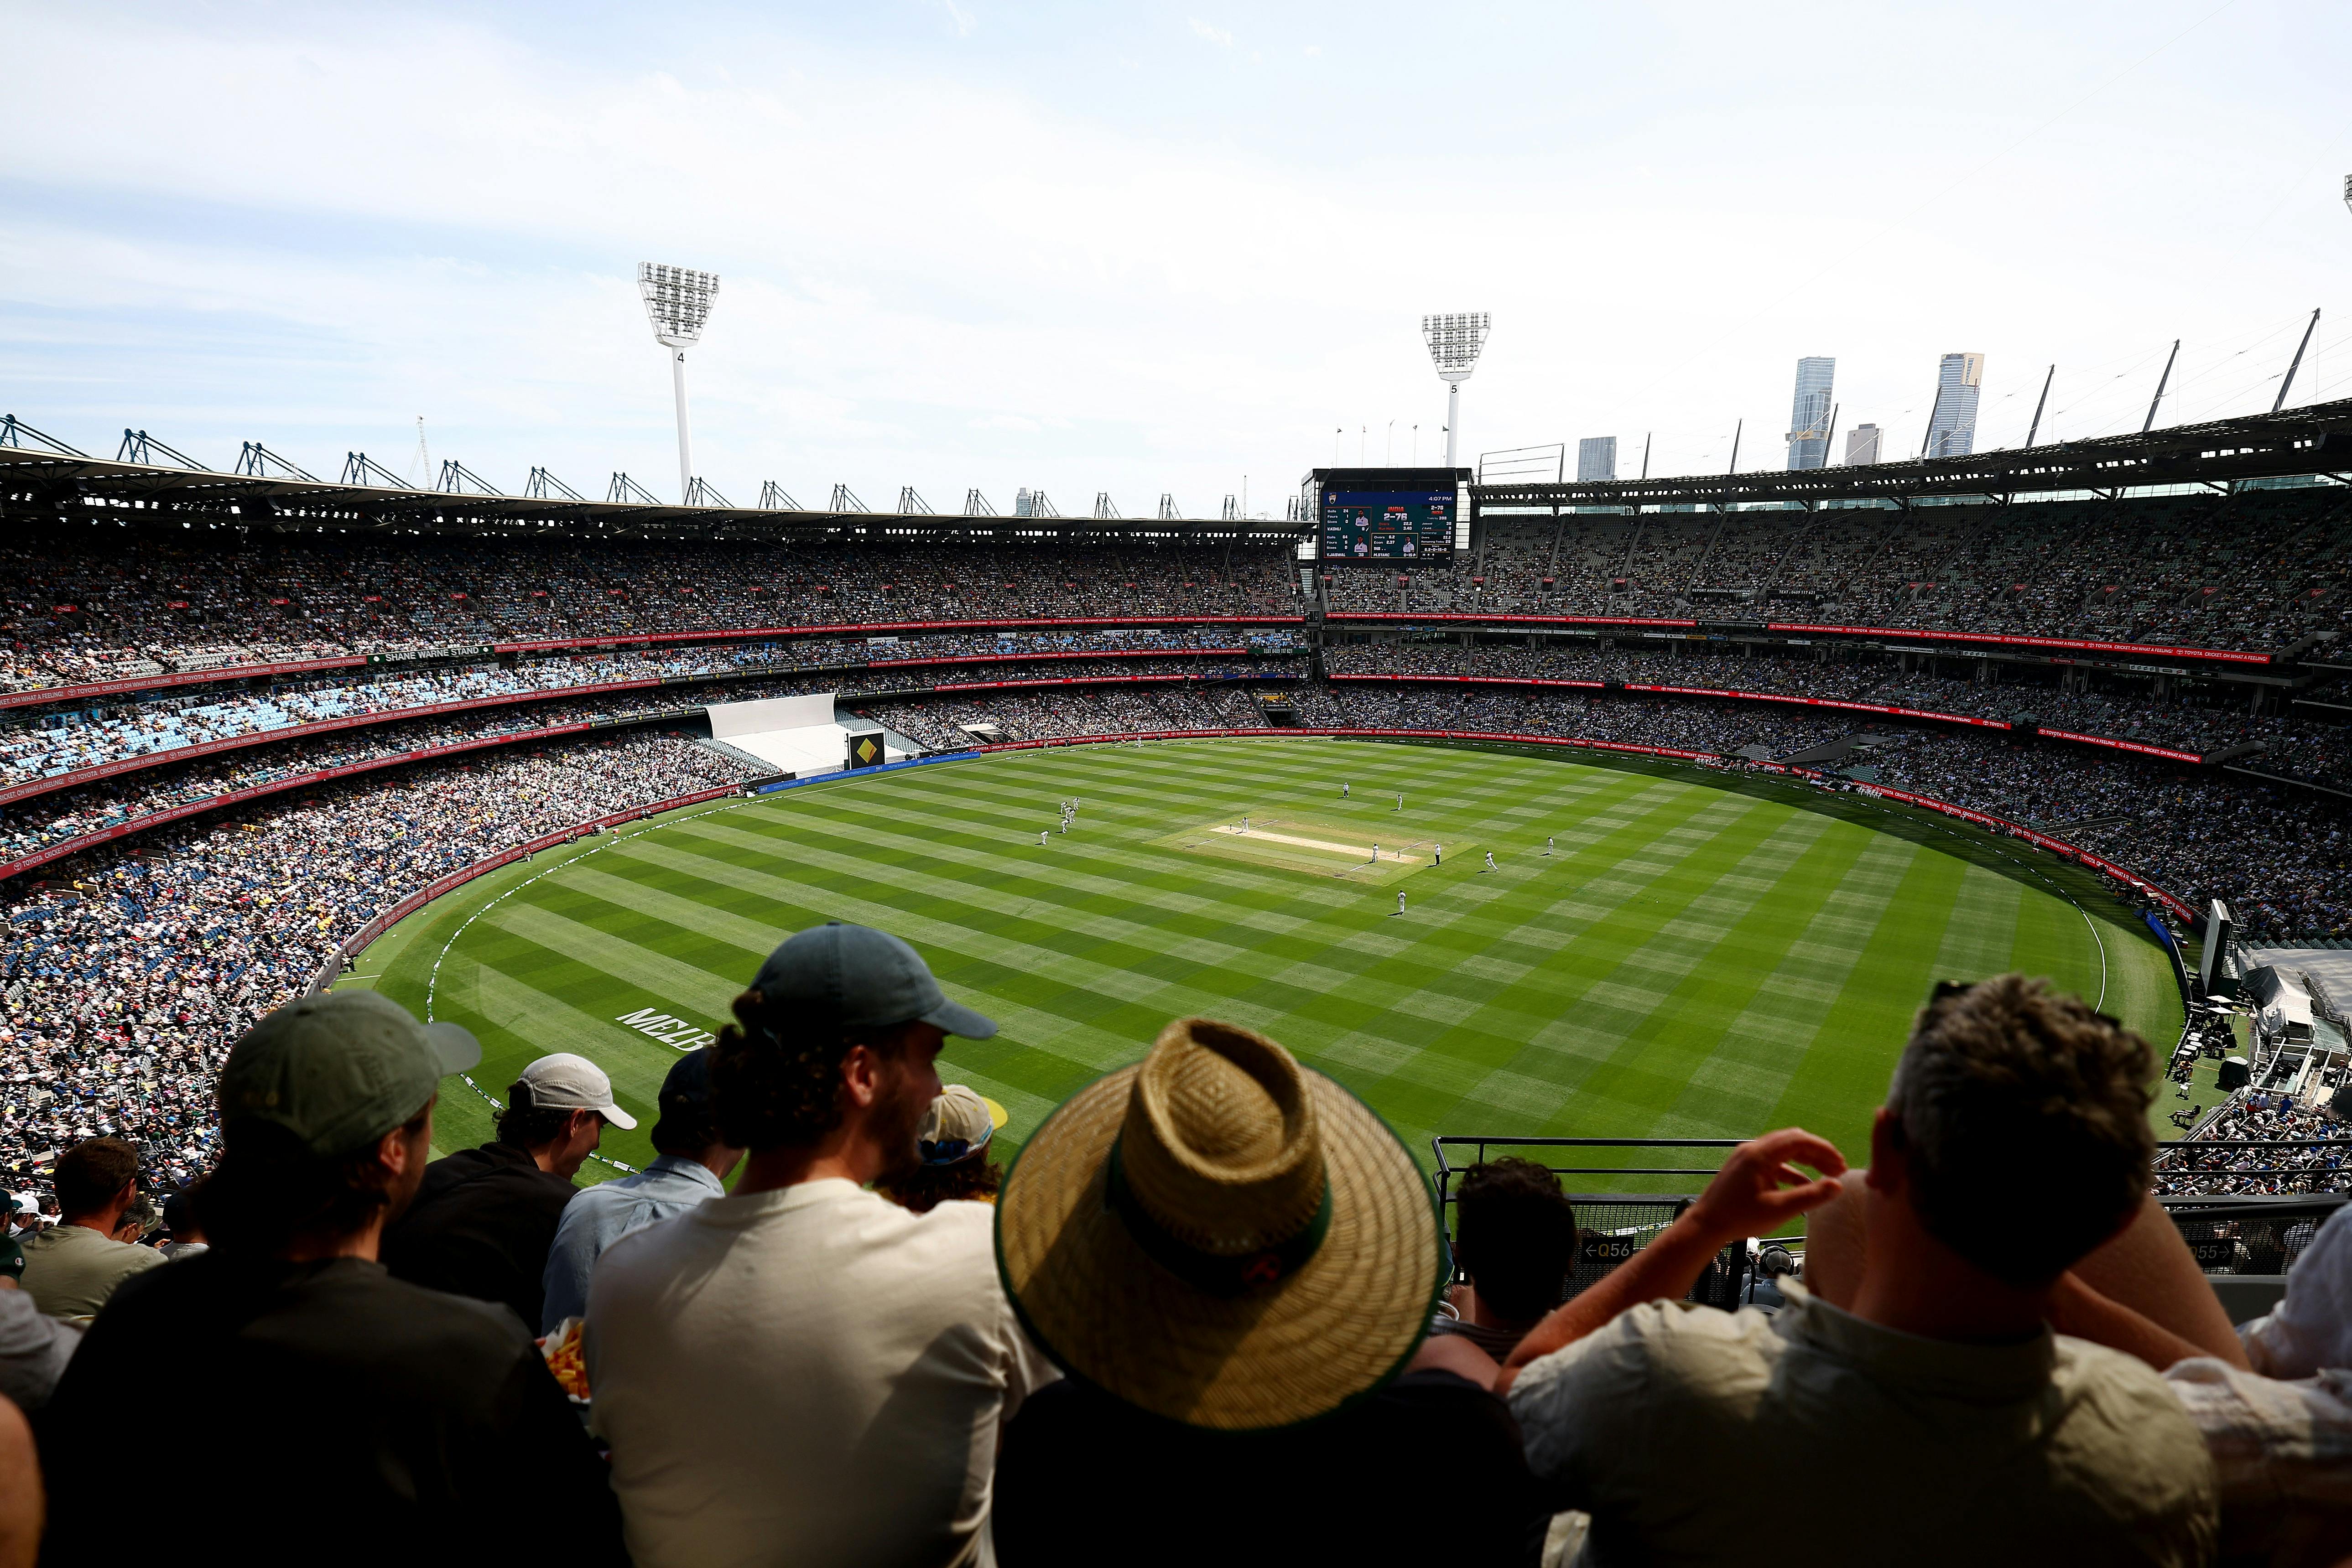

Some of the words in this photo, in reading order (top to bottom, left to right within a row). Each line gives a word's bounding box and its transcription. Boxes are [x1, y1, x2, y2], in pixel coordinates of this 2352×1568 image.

[678, 352, 684, 363] 4
[1451, 385, 1457, 393] 5
[385, 652, 416, 661] SHANE
[417, 649, 449, 659] WARNE
[451, 647, 479, 656] STAND
[134, 819, 151, 827] TOYOTA
[198, 800, 217, 808] FEELING!
[1598, 1244, 1629, 1257] Q56
